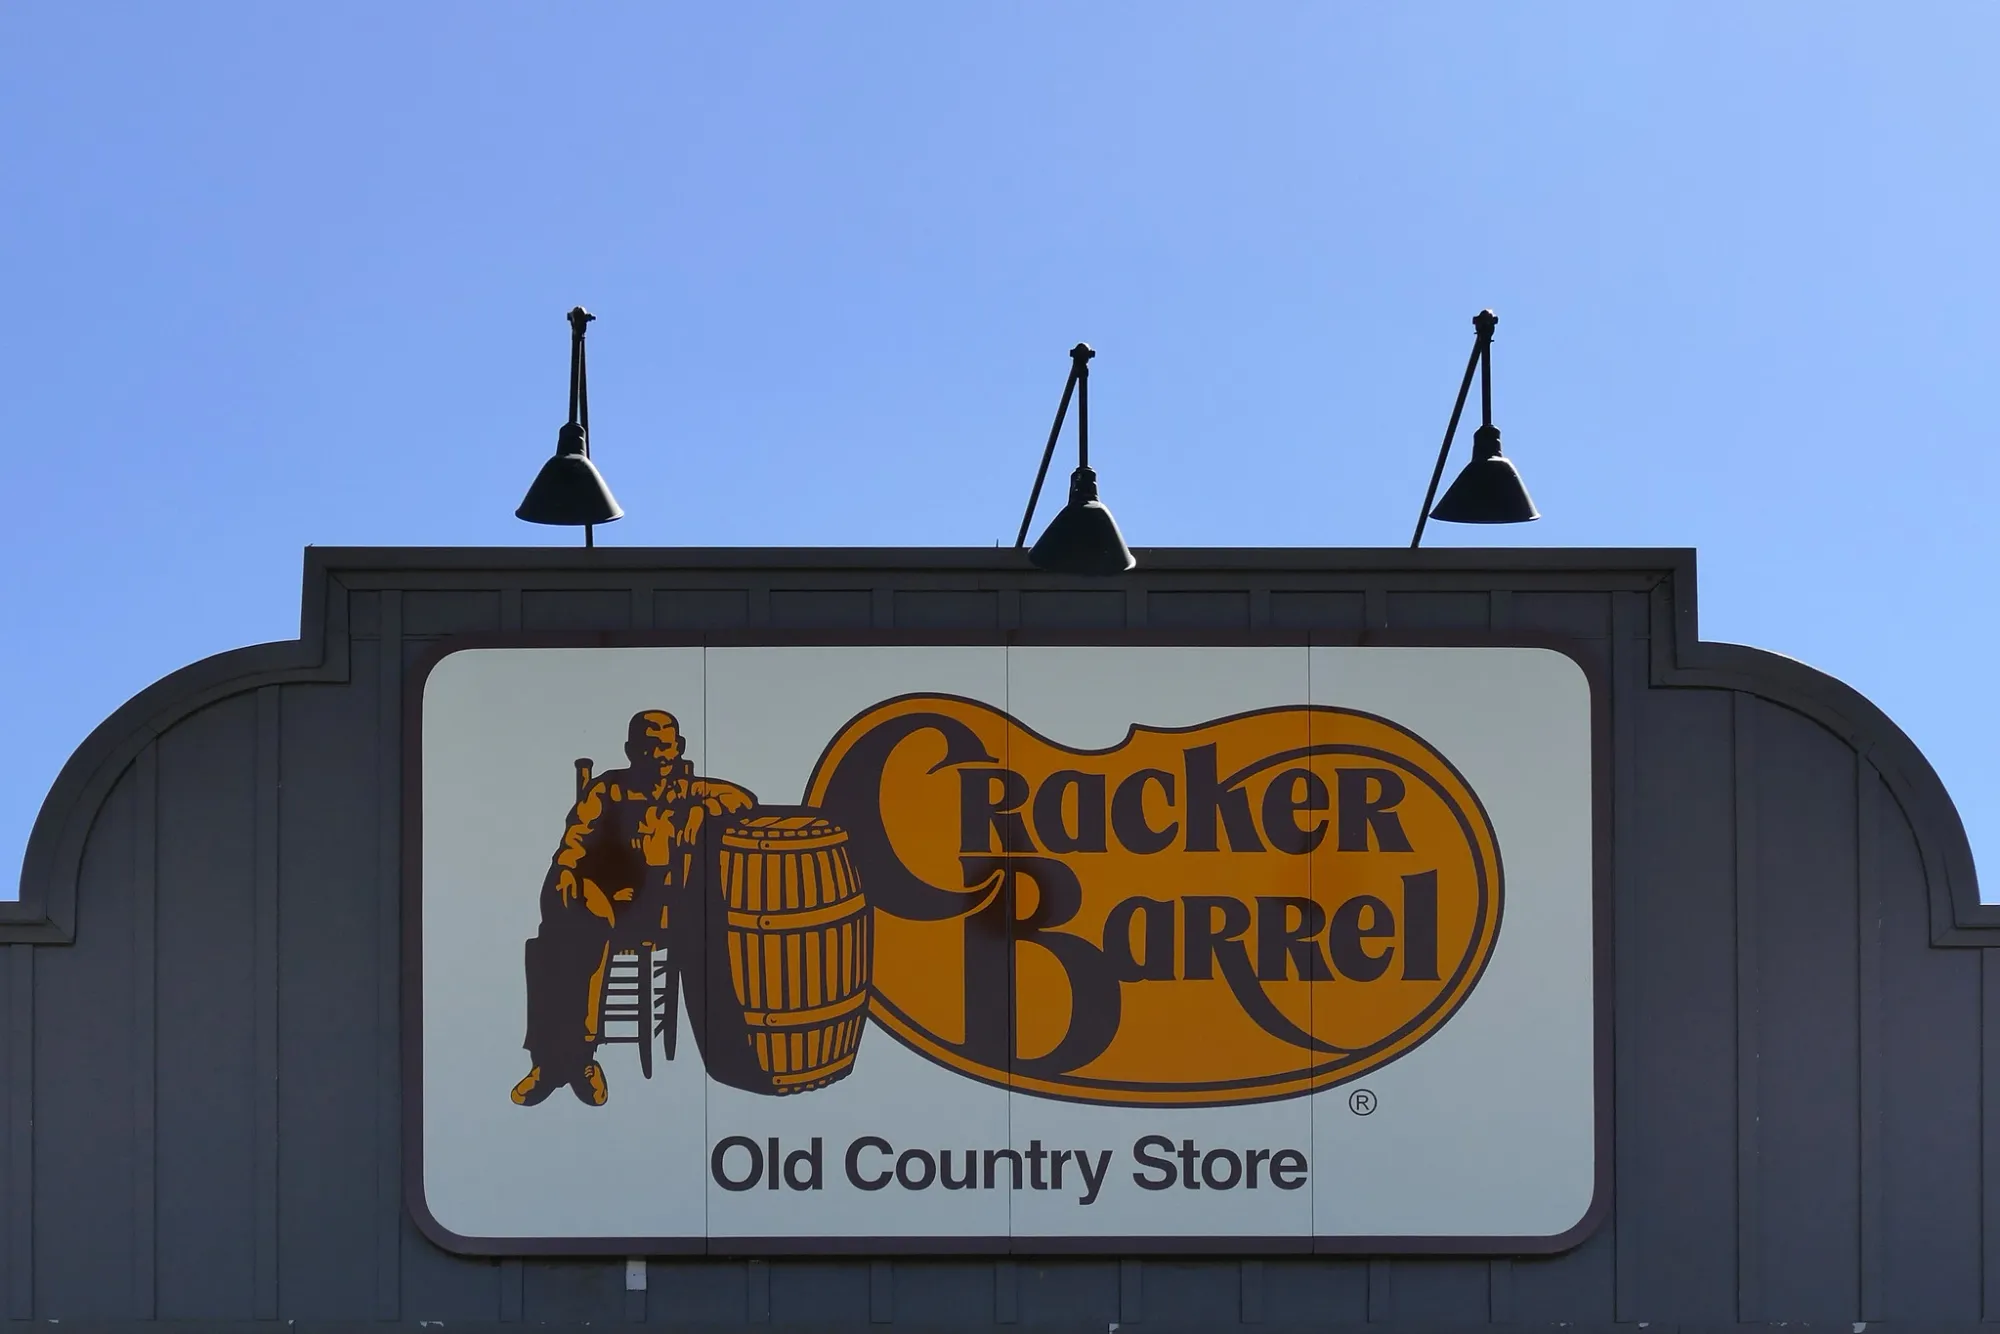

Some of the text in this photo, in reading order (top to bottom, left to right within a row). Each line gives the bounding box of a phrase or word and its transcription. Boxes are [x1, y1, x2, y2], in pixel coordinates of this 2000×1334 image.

[711, 1134, 1308, 1205] Old Country Store
